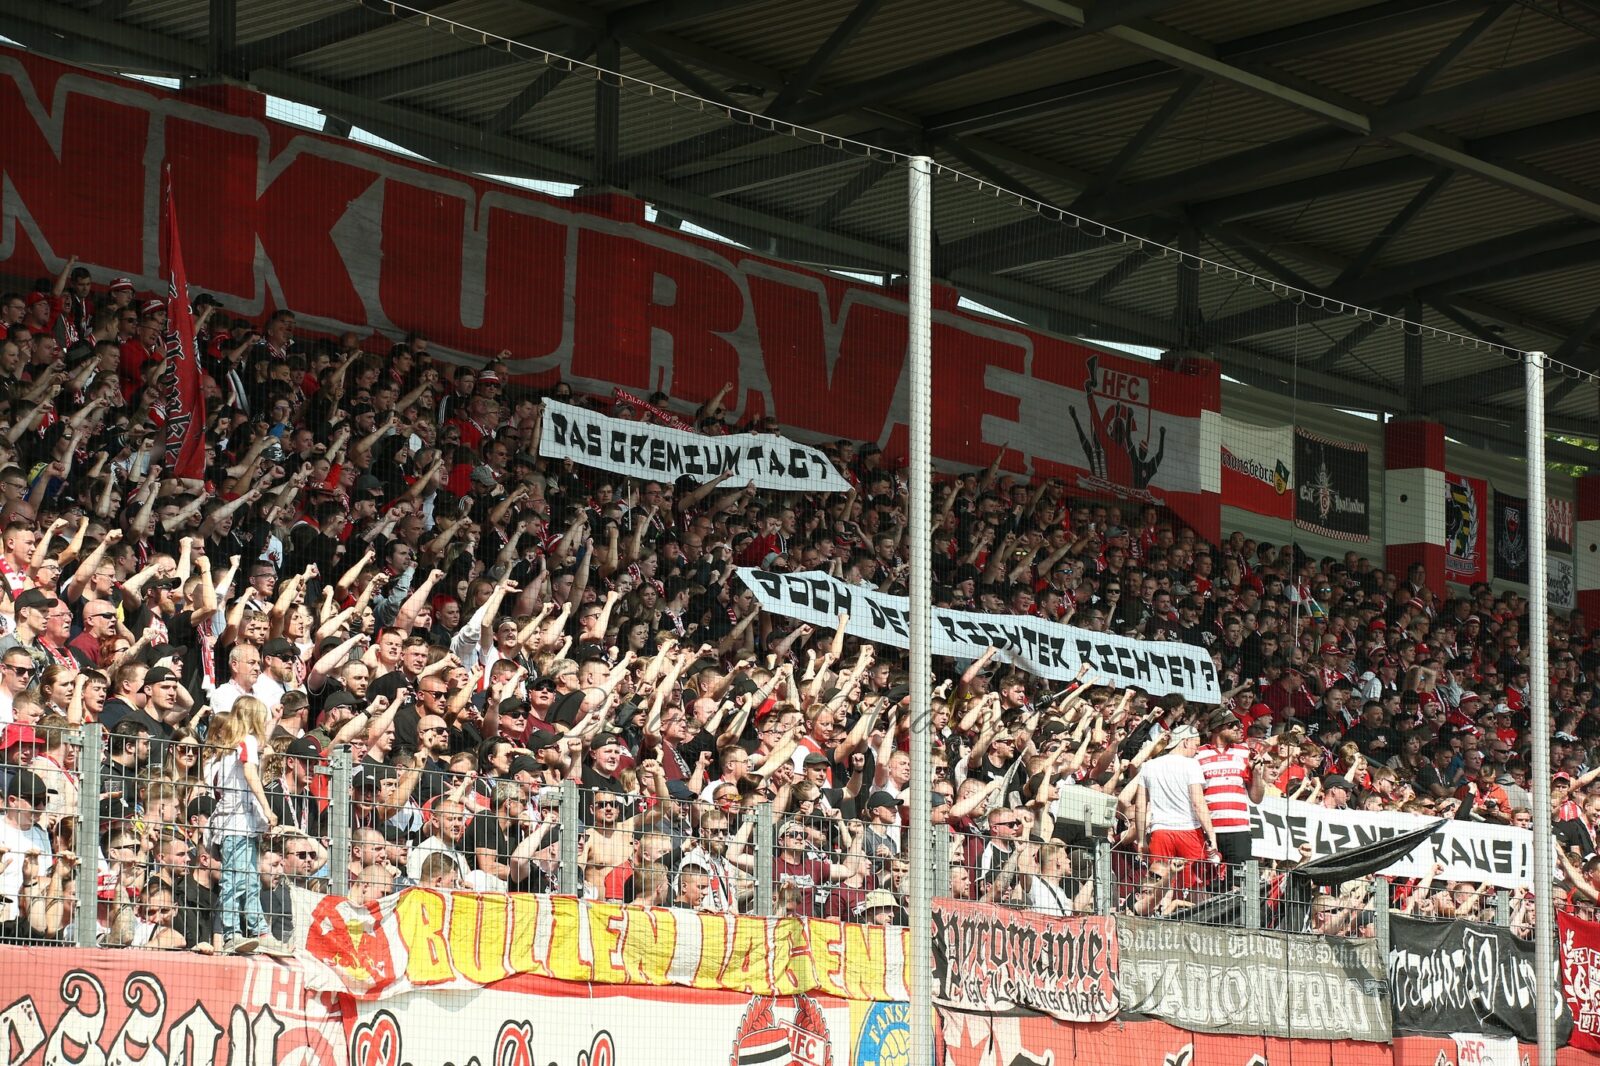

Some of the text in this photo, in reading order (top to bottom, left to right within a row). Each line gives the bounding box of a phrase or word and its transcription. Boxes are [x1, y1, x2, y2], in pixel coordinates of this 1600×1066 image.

[1102, 368, 1141, 402] HFC
[551, 413, 827, 480] DAS GREMIUM TAGT
[1221, 452, 1274, 483] raunsbedra
[751, 570, 1215, 691] DOCH DE RICHTER RICHTET?
[1431, 832, 1527, 877] RAUS!
[396, 887, 677, 986] BULLEN
[689, 912, 894, 1002] JAGEN
[1119, 957, 1389, 1033] STADIONVERBOT
[788, 1027, 817, 1060] HFC
[1460, 1039, 1485, 1063] HFC
